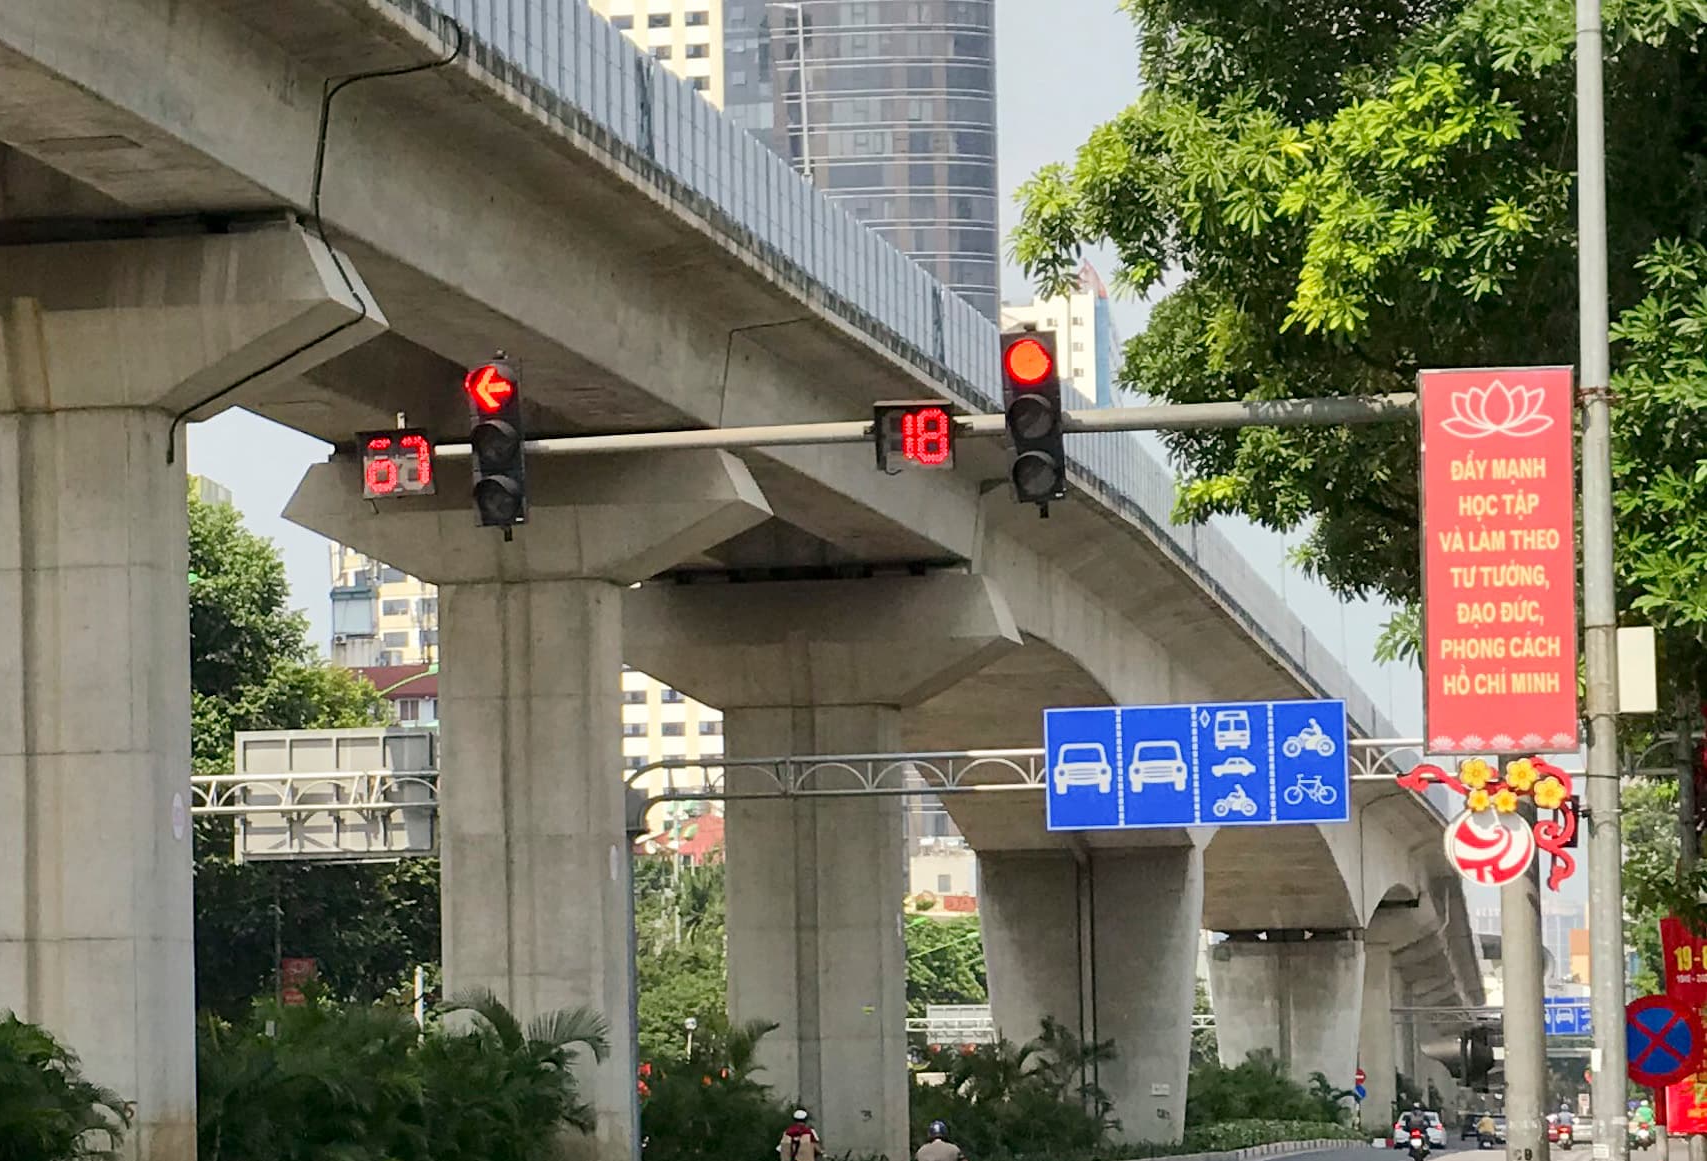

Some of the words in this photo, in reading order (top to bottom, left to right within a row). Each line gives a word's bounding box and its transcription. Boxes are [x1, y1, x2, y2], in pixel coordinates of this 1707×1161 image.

[901, 408, 949, 465] 18
[1450, 450, 1488, 482] ĐẨY
[1491, 457, 1547, 485] MẠNH
[1458, 494, 1498, 522] HỌC
[1501, 488, 1540, 521] TẬP
[1438, 524, 1466, 553] VÀ
[1468, 524, 1506, 553] LÀM
[1509, 528, 1560, 551] THEO
[1450, 564, 1478, 589] TƯ
[1480, 559, 1550, 590] TƯỞNG,
[1456, 601, 1497, 630] ĐẠO
[1500, 596, 1545, 627] ĐỨC,
[1441, 636, 1506, 660] PHONG
[1509, 632, 1561, 659] CÁCH
[1443, 663, 1471, 695] HỒ
[1473, 668, 1506, 696] CHÍ
[1510, 671, 1560, 694] MINH
